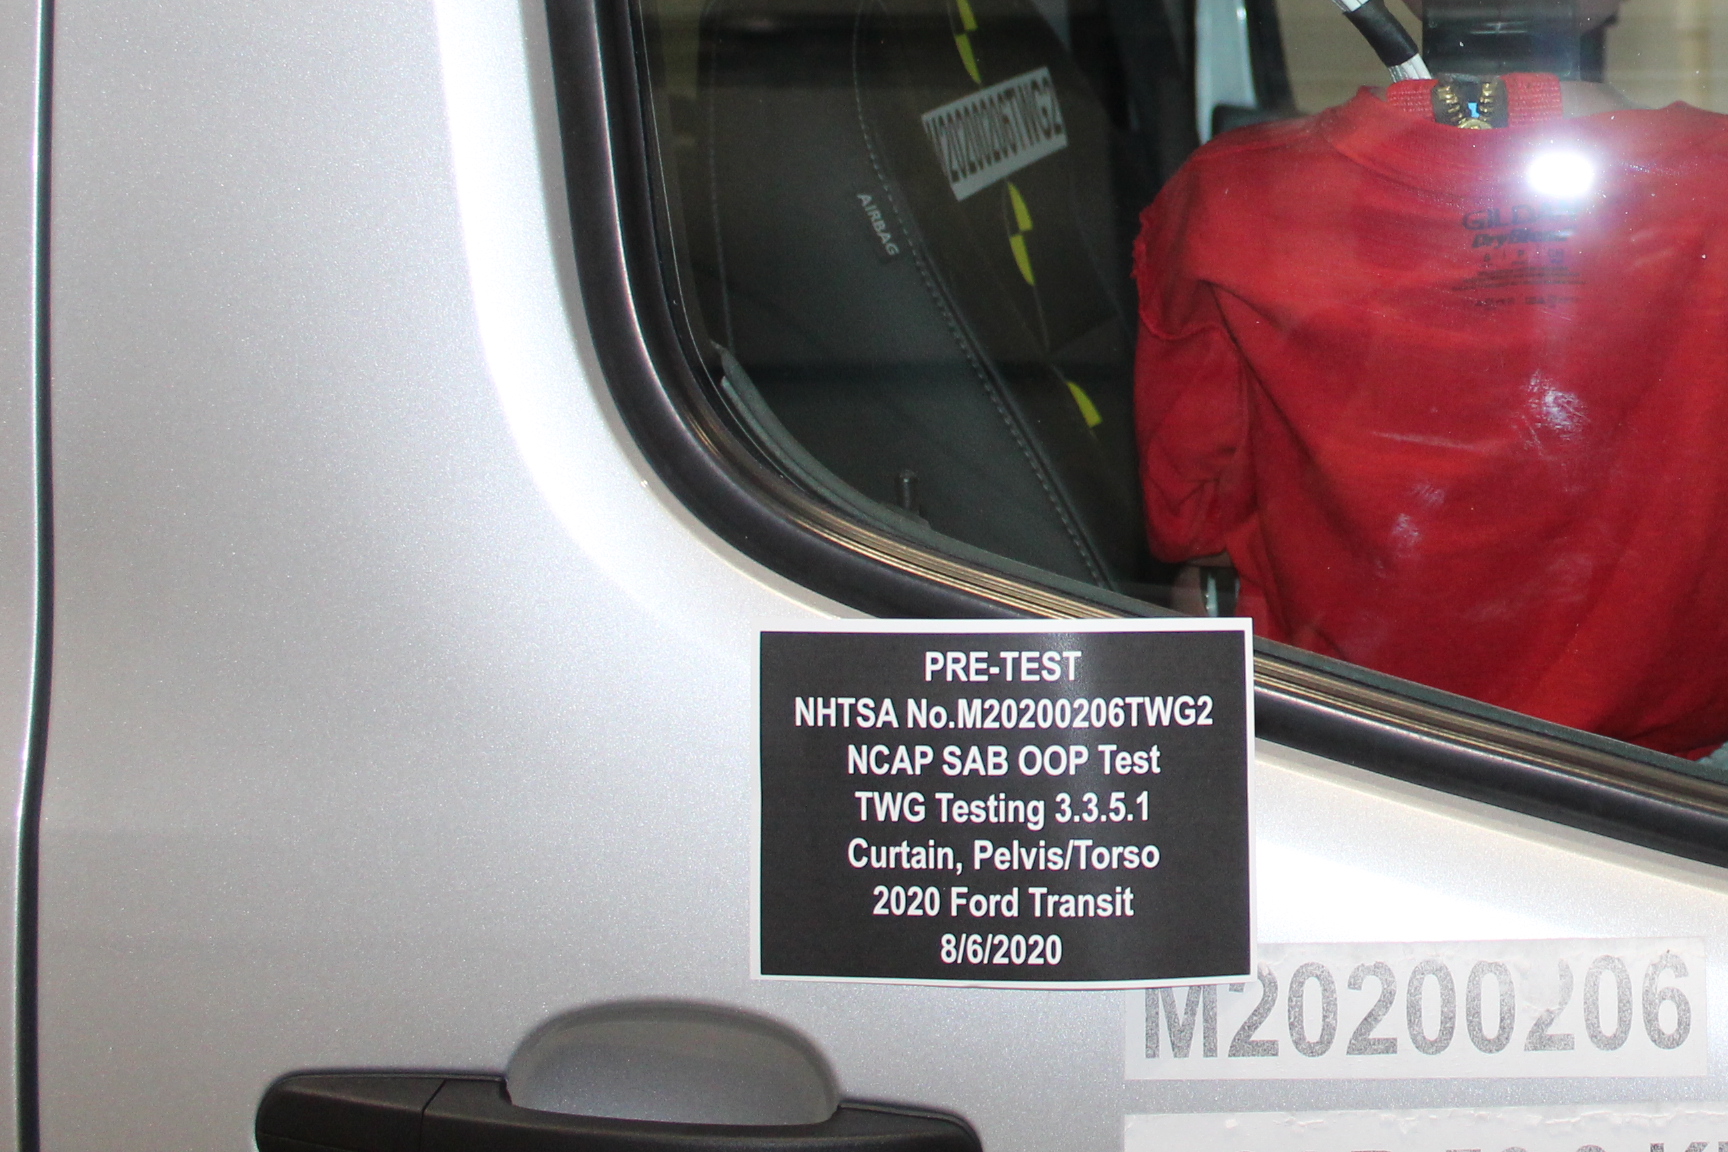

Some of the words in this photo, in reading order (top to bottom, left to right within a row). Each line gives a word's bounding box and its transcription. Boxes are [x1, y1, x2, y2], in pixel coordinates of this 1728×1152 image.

[856, 192, 900, 257] AIRBAG
[925, 650, 1082, 682] PRE-TEST
[795, 696, 899, 729] NHTSA
[907, 694, 1213, 729] No.M20200206TWG2
[848, 744, 934, 775] NCAP
[942, 744, 1009, 776] SAB
[1018, 744, 1089, 776] OOP
[1098, 744, 1161, 774] Test
[855, 791, 926, 822] TWG
[935, 793, 1045, 831] Testing
[1055, 790, 1149, 823] 3.3.5.1
[848, 837, 963, 876] Curtain,
[973, 839, 1160, 871] Pelvis/Torso
[872, 885, 941, 917] 2020
[950, 886, 1019, 918] Ford
[1028, 886, 1135, 918] Transit
[940, 933, 1062, 965] 8/6/2020
